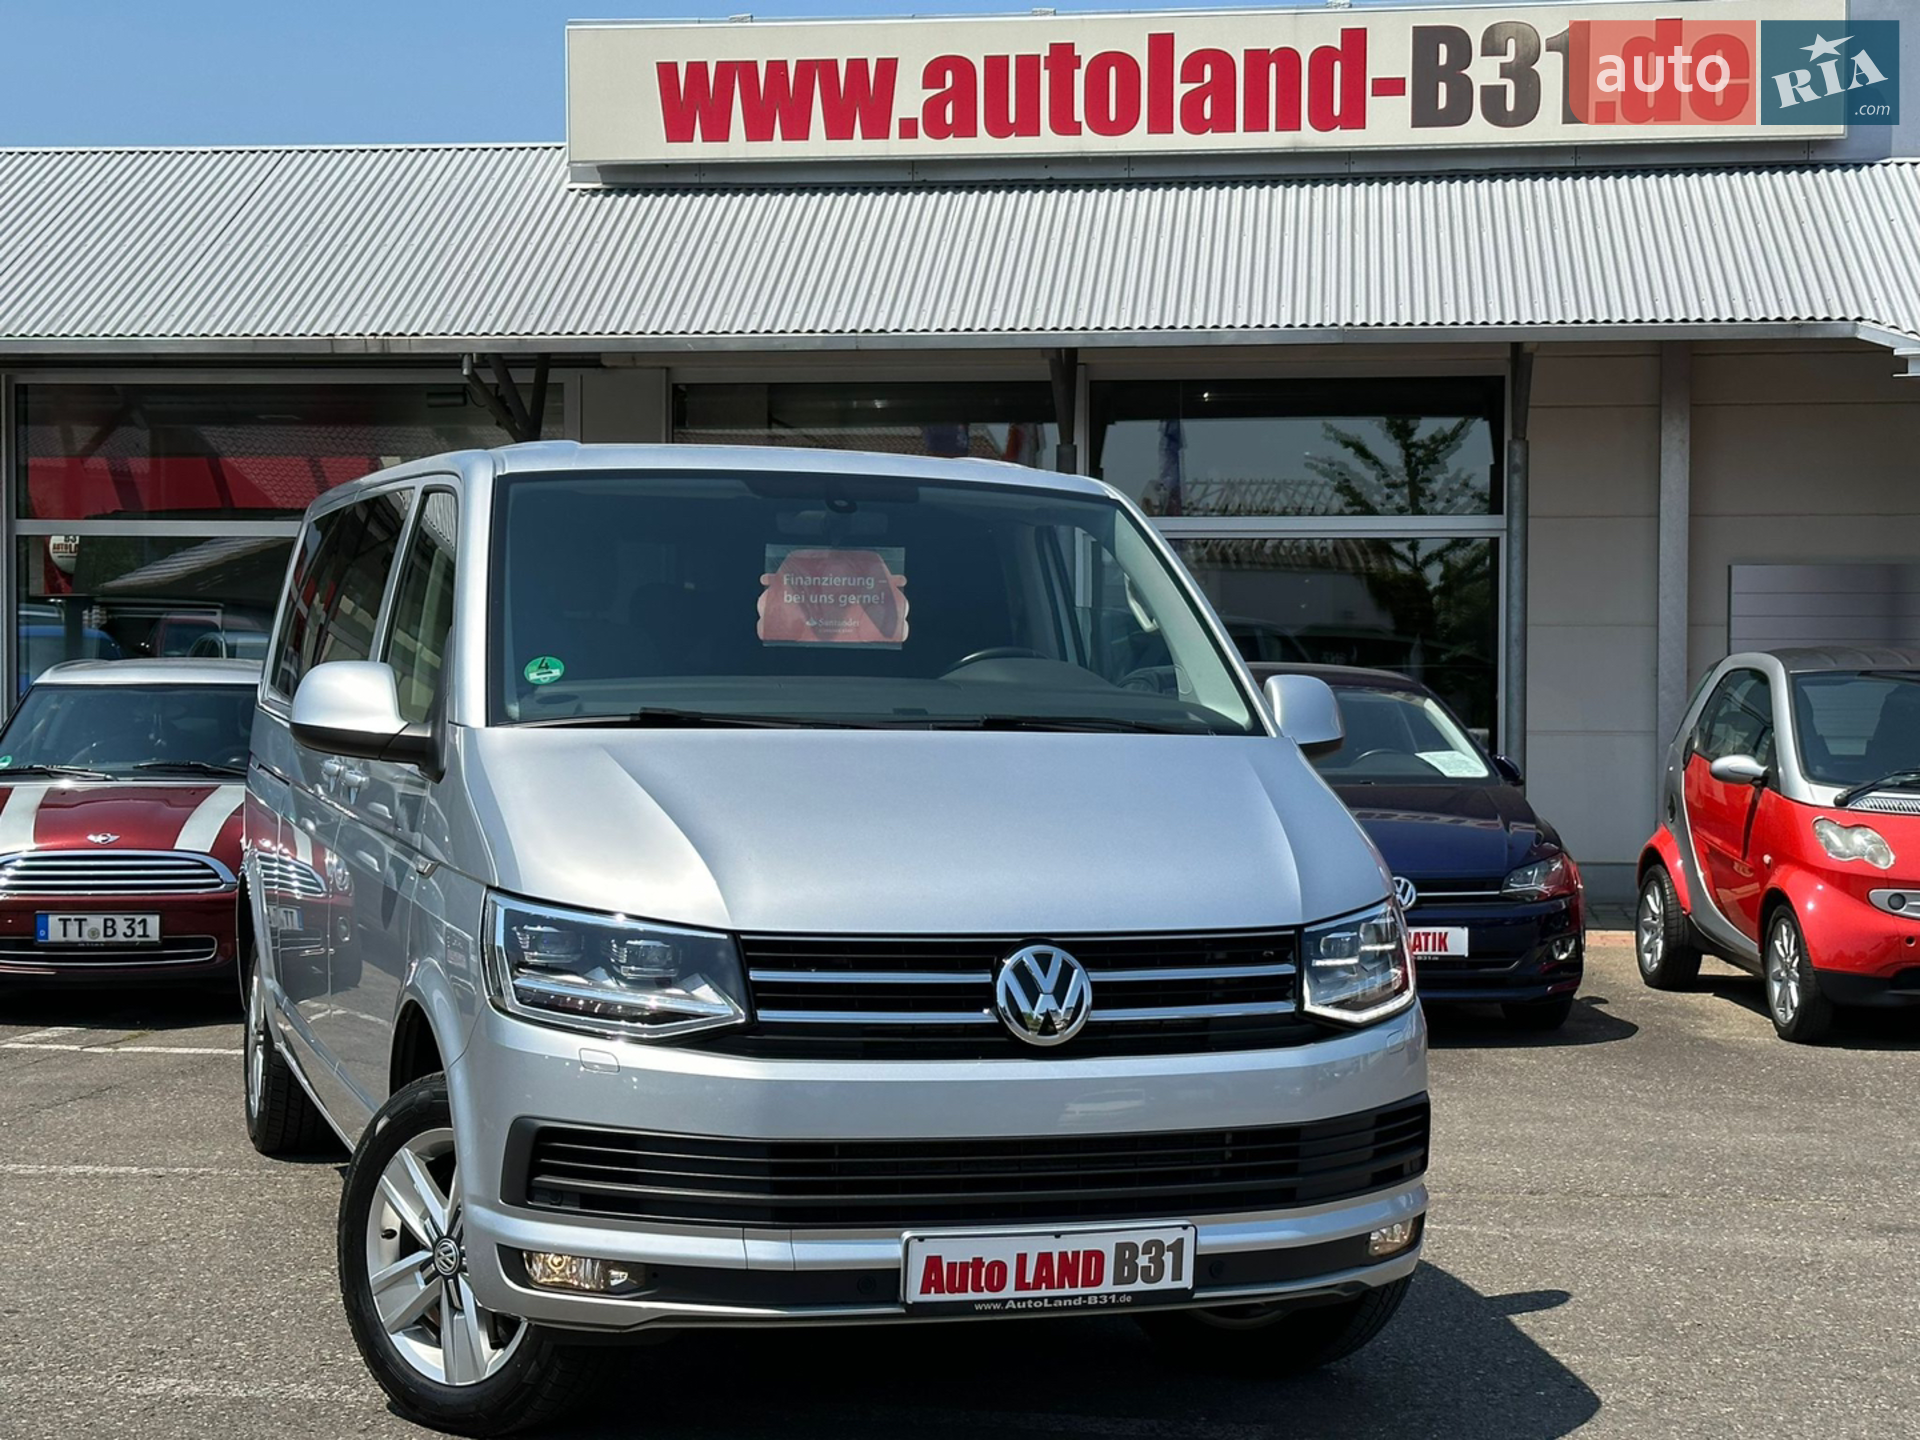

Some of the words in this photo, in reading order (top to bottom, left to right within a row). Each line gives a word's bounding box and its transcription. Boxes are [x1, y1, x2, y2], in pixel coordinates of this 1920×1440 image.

[783, 573, 875, 589] Finanzierung
[783, 591, 805, 604] bei
[809, 593, 835, 604] uns
[838, 591, 886, 607] gerne!
[537, 656, 550, 670] 4
[58, 917, 87, 938] TT
[103, 917, 117, 938] B
[122, 917, 150, 938] 31
[1408, 931, 1449, 952] ATIK
[919, 1255, 1008, 1295] Auto
[1013, 1248, 1106, 1292] LAND
[1112, 1236, 1186, 1287] B31
[974, 1293, 1133, 1311] www.AutoLand-B31.de
